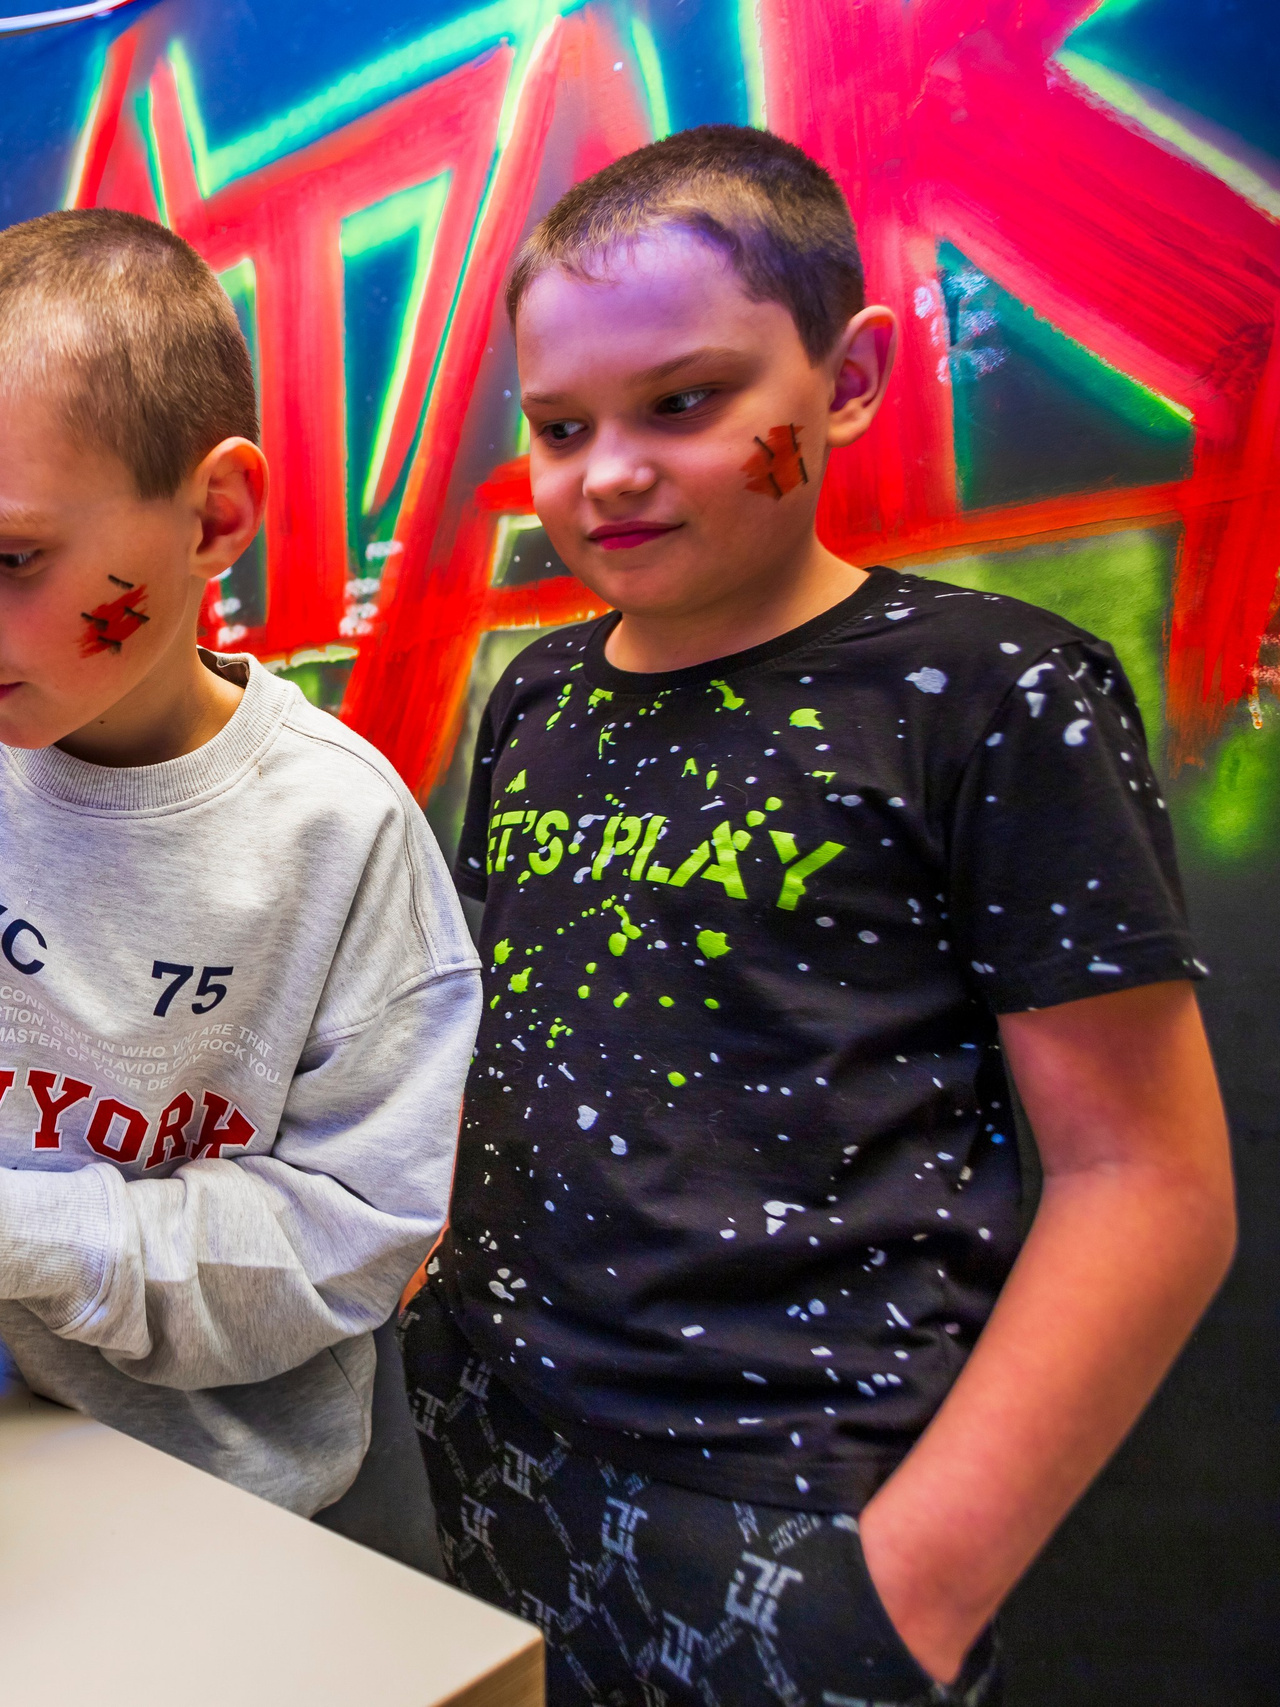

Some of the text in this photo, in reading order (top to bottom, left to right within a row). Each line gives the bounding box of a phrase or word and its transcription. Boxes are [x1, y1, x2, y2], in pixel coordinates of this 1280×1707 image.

[487, 810, 847, 911] ET'S PLAY
[0, 985, 93, 1043] CONFIDENT
[97, 1040, 116, 1054] IN
[121, 1046, 166, 1059] WHO
[173, 1030, 197, 1055] YOU
[199, 1023, 234, 1037] ARE
[238, 1026, 273, 1058] THAT
[152, 960, 234, 1017] 75
[52, 1025, 75, 1045] OR
[79, 1043, 169, 1075] BEHAVIOR
[197, 1038, 247, 1061] ROCK
[248, 1054, 282, 1086] YOU.
[66, 1045, 89, 1063] OF
[93, 1061, 142, 1090] YOUR
[24, 1067, 260, 1172] YORK
